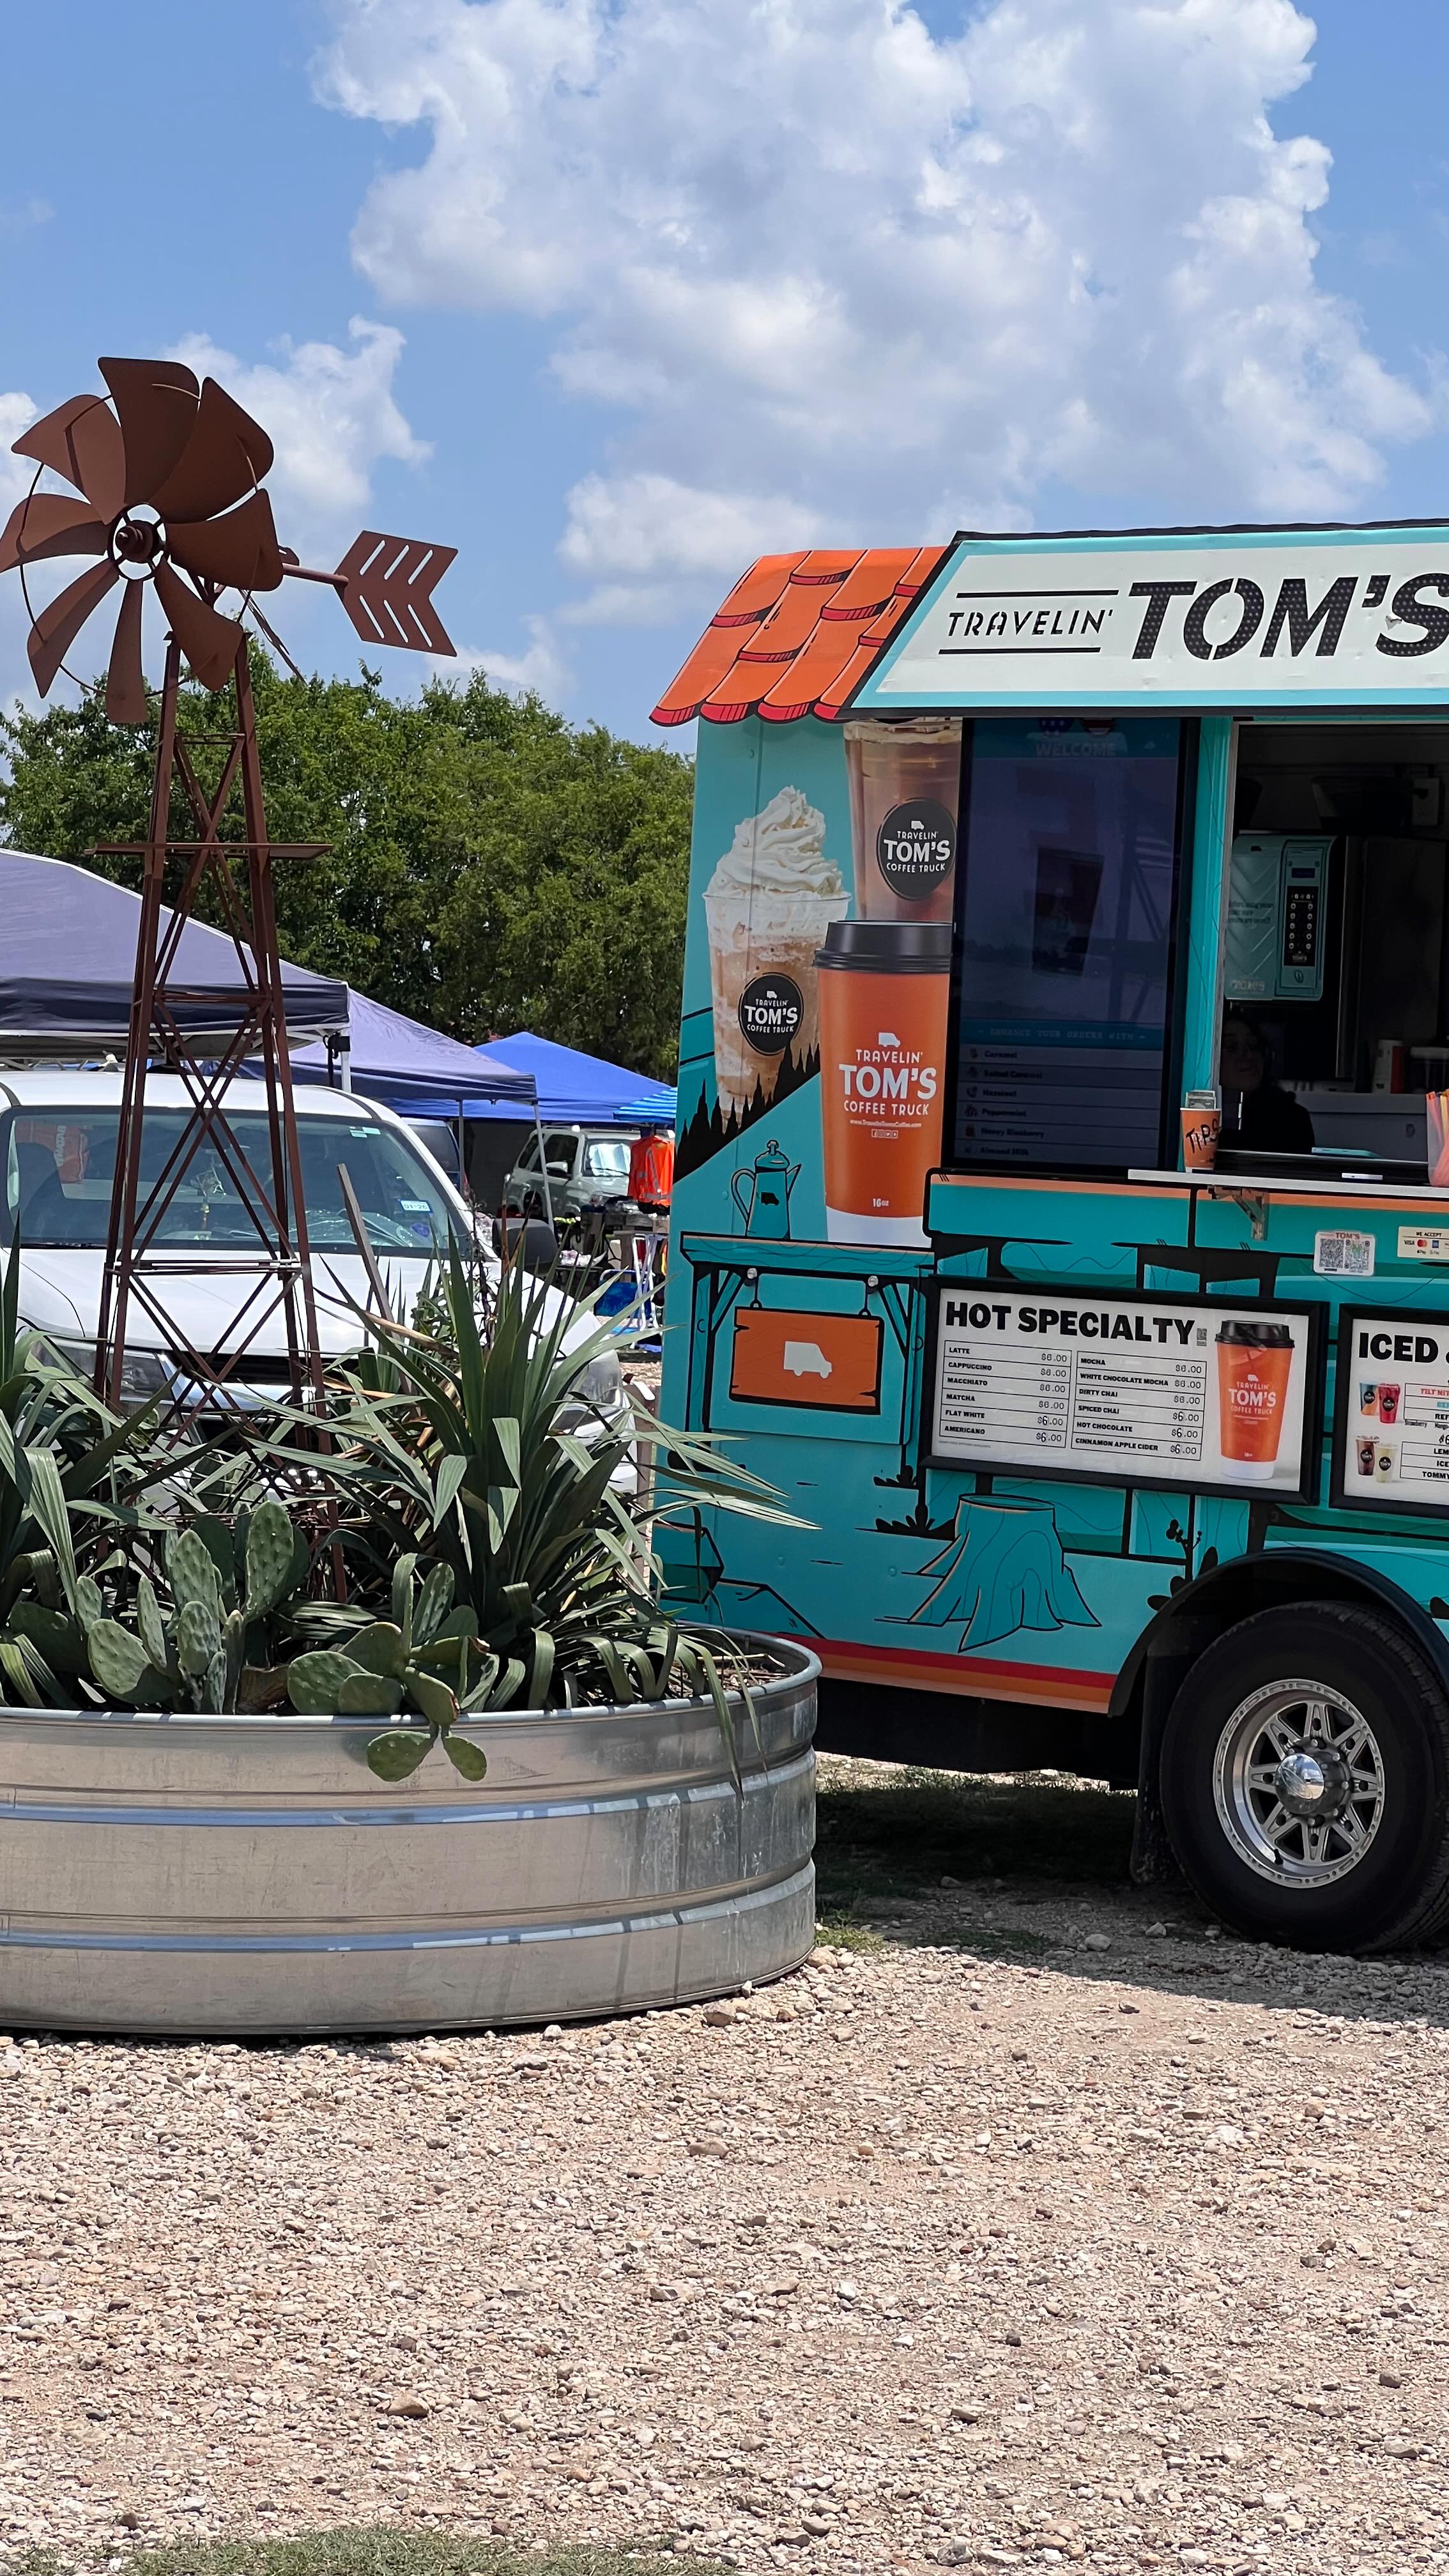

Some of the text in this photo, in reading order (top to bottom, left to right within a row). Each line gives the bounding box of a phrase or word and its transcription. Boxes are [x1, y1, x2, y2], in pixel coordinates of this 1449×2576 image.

[948, 572, 1449, 661] TRAVELIN' TOM'S
[1036, 742, 1117, 756] WELCOME
[884, 839, 951, 862] TOM'S
[886, 862, 946, 873] COFFEE TRUCK
[744, 1005, 798, 1025] TOM'S
[747, 1024, 770, 1033] COFFEE
[1037, 1029, 1061, 1038] YOUR
[1109, 1031, 1135, 1041] WITH
[856, 1049, 923, 1064] TRAVELIN'
[985, 1050, 1018, 1059] Caramel
[839, 1063, 937, 1099] TOM'S
[1010, 1070, 1043, 1079] Caramel
[983, 1089, 1017, 1098] Hazelnut
[844, 1100, 930, 1116] COFFEE TRUCK
[982, 1108, 1027, 1118] Peppermint
[1186, 1118, 1218, 1154] TIPS
[946, 1301, 1195, 1345] HOT SPECIALTY
[1358, 1332, 1438, 1363] ICED
[948, 1361, 992, 1371] CAPPUCCINO
[947, 1377, 988, 1386] MACCHIATO
[1103, 1375, 1142, 1383] CHOCOLATE
[946, 1393, 976, 1402] MATCHA
[1228, 1388, 1276, 1407] TOM'S
[1172, 1411, 1199, 1422] $6.00
[1230, 1406, 1252, 1414] COFFEE
[1037, 1415, 1063, 1427] $6.00
[944, 1425, 1062, 1442] AMERICANO $6.00
[1092, 1423, 1133, 1432] CHOCOLATE
[1171, 1427, 1198, 1438] $6.00
[1075, 1438, 1113, 1446] CINNAMON
[1170, 1444, 1197, 1455] $6.00
